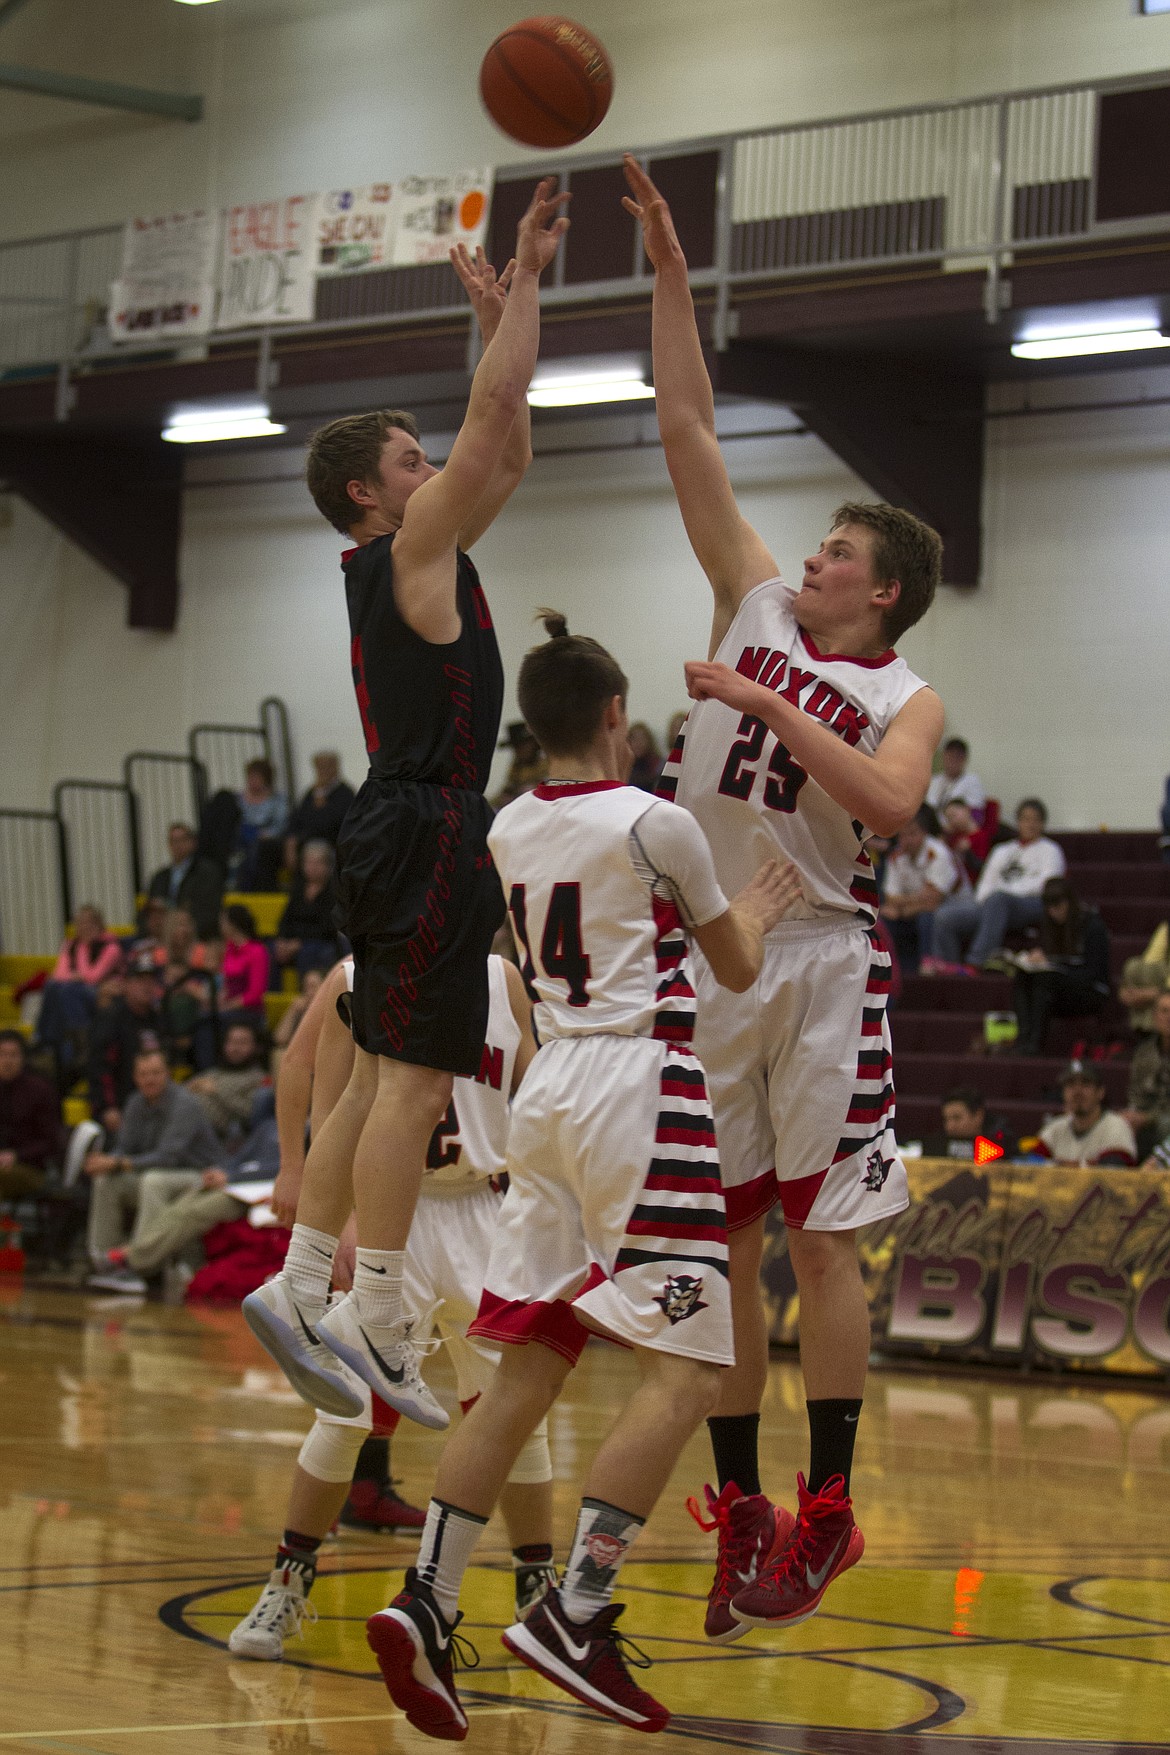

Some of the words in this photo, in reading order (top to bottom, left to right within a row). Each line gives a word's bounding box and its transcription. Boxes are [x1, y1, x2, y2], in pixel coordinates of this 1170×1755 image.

[735, 646, 870, 747] NOXON
[717, 713, 808, 814] 25
[508, 881, 592, 1007] 14
